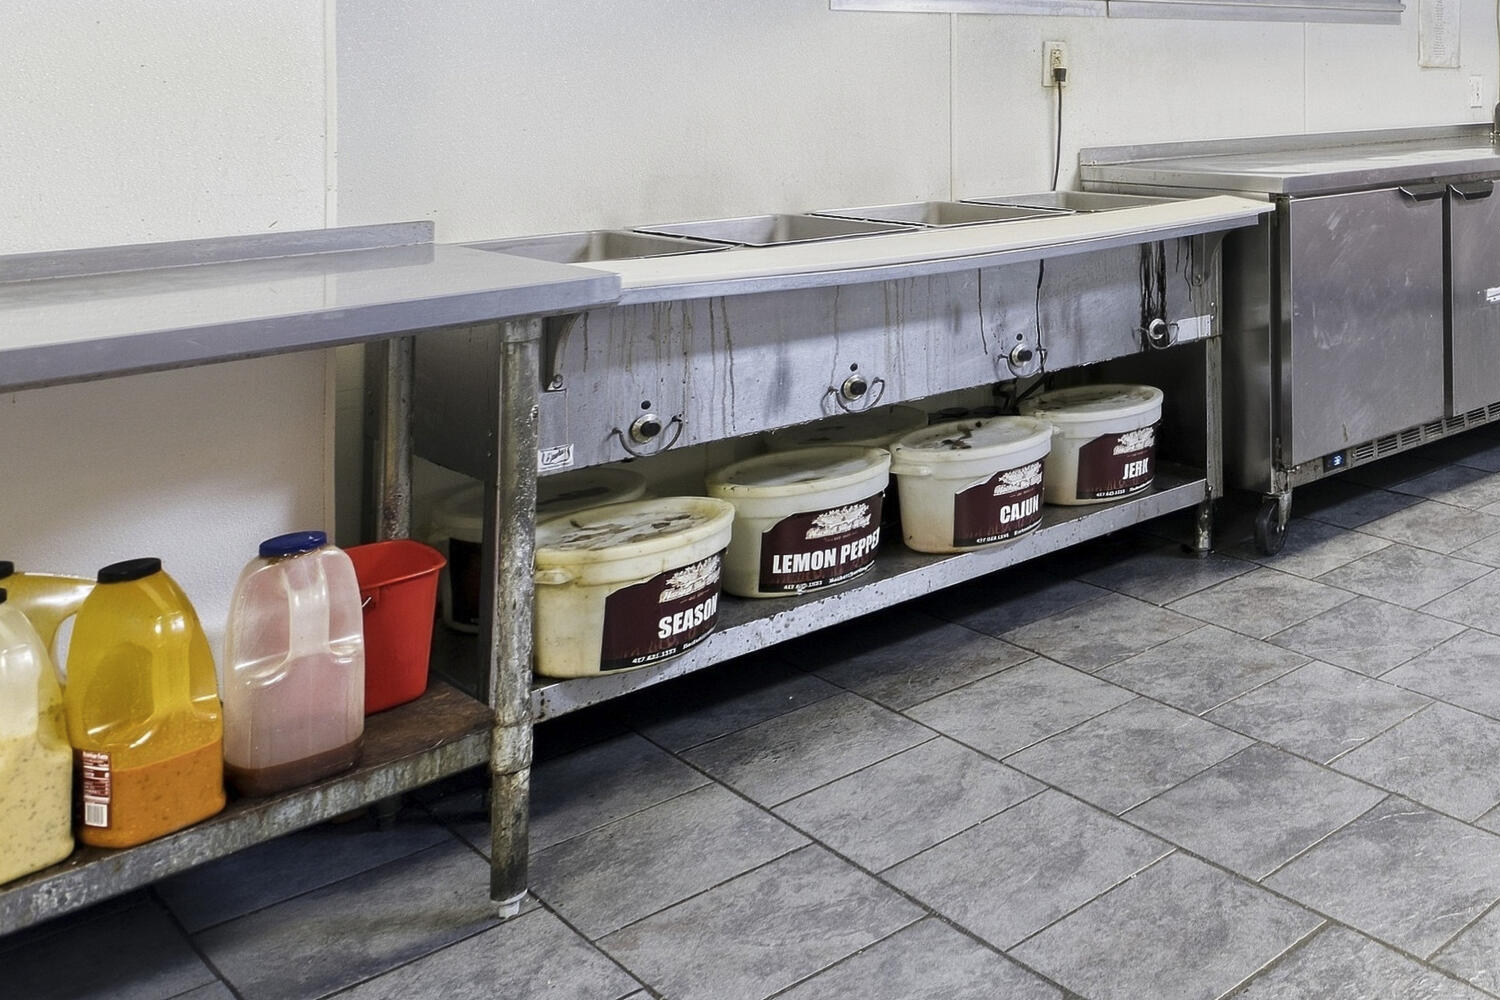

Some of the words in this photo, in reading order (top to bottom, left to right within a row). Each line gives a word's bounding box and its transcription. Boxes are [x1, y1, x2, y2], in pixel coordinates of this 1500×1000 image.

[1122, 457, 1149, 480] JERK
[1000, 494, 1039, 524] CAJUN
[772, 547, 837, 574] LEMON
[658, 592, 718, 639] SEASON
